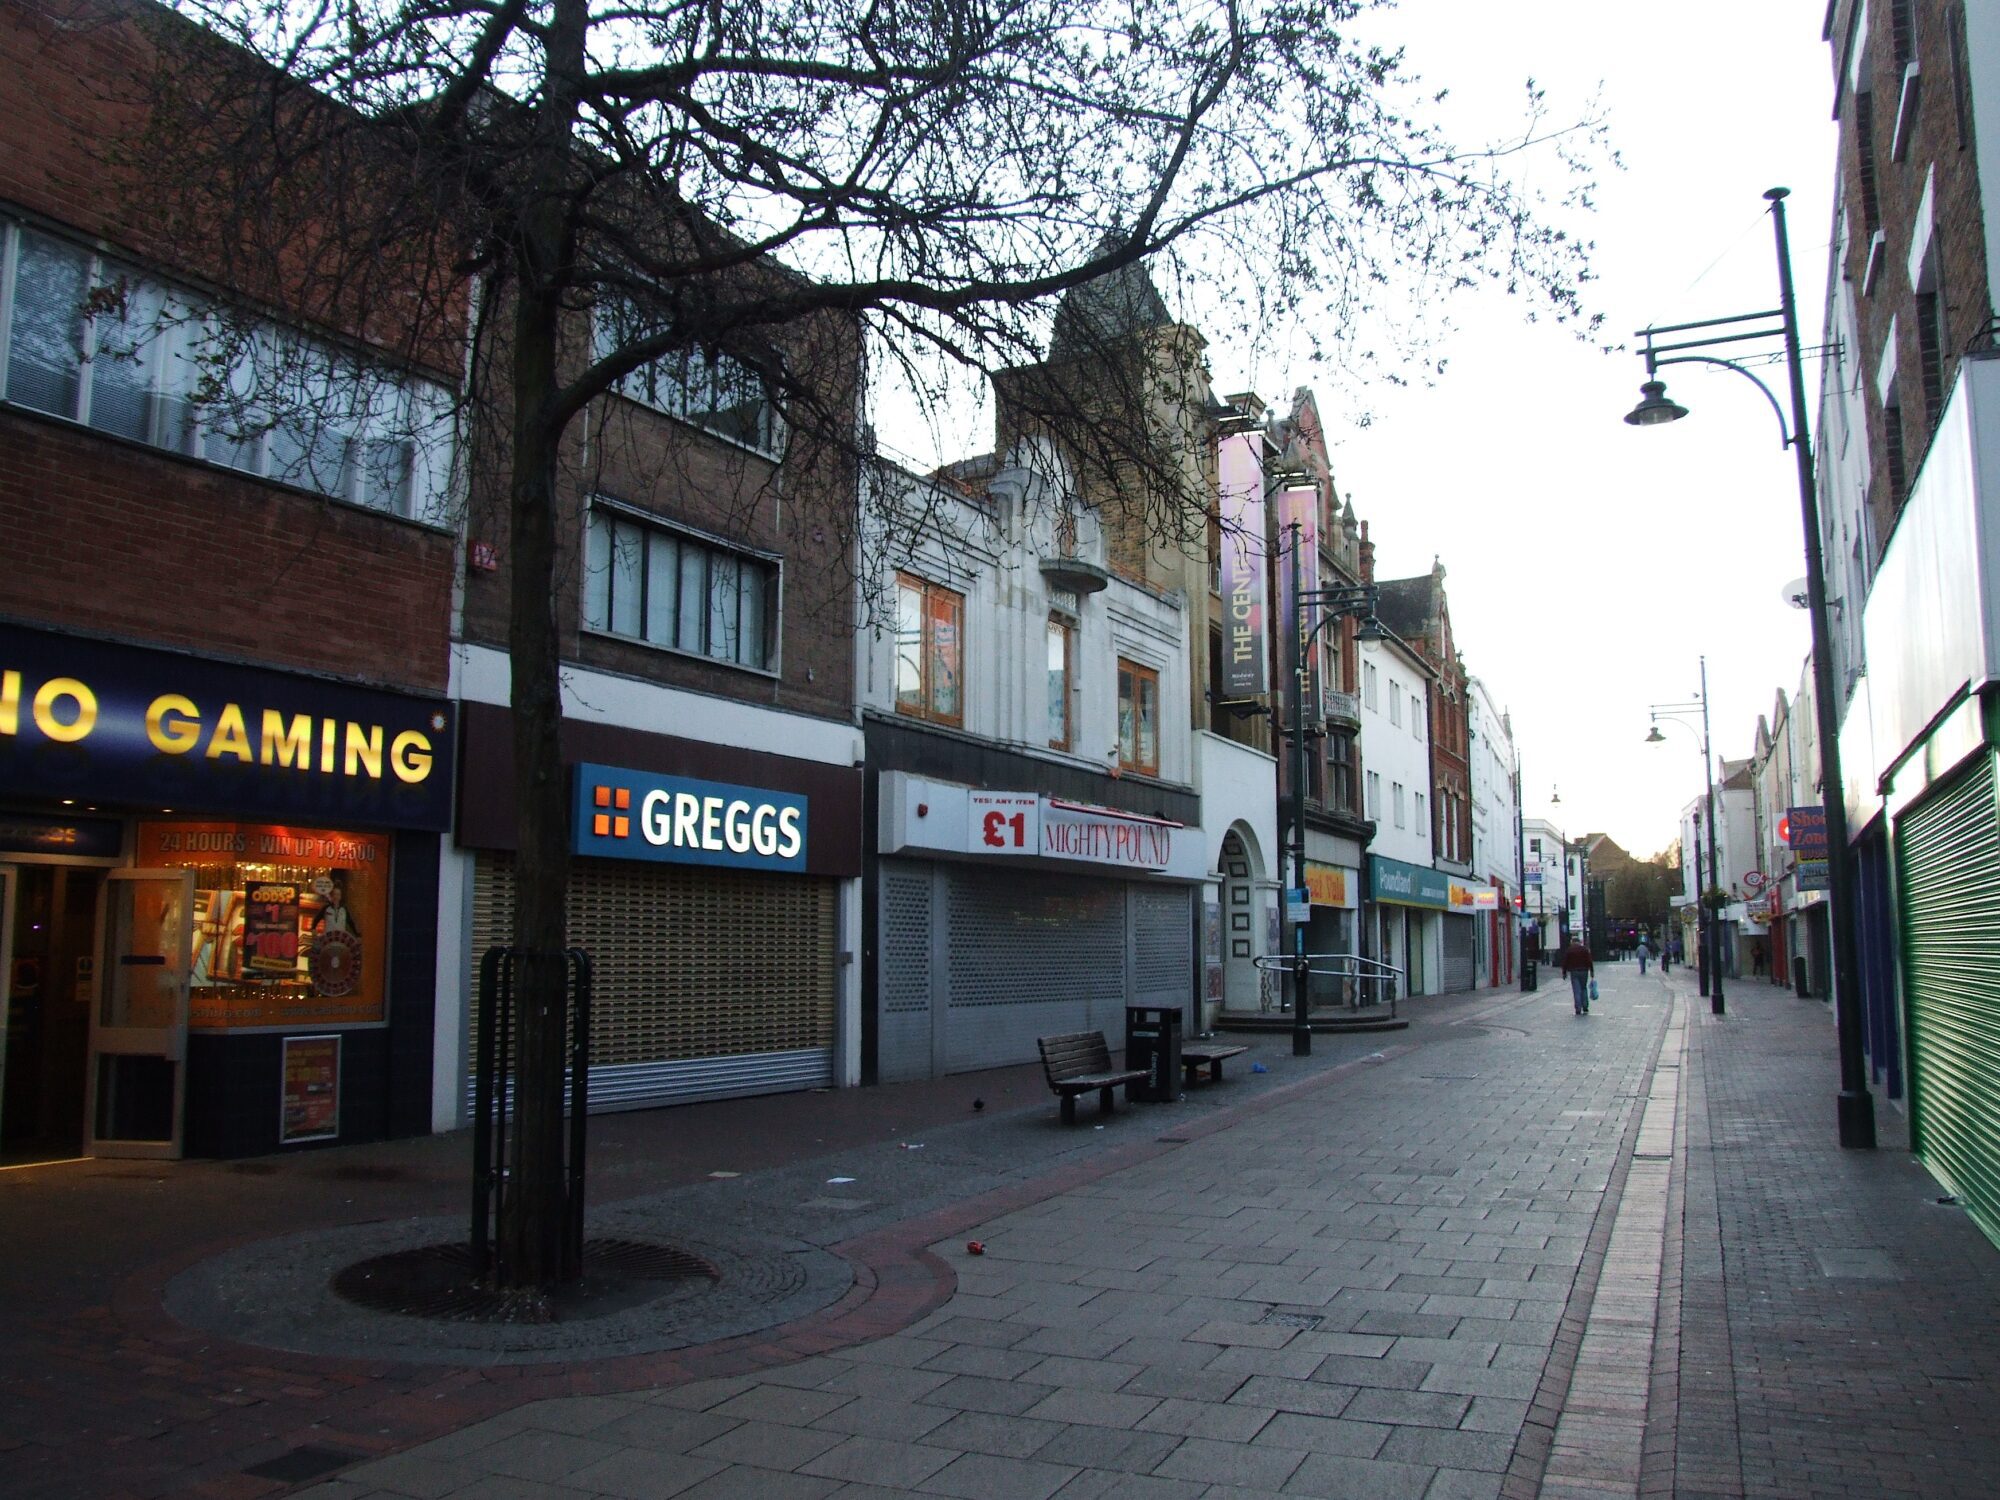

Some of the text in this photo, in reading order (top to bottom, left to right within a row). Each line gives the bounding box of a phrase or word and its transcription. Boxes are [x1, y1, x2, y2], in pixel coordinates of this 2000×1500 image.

[1233, 625, 1253, 664] THE
[144, 692, 433, 784] GAMING
[641, 789, 802, 858] GREGGS
[983, 811, 1025, 848] £1
[159, 832, 376, 861] 24 HOURS WIN UP TO £500
[252, 886, 296, 904] ODDS?
